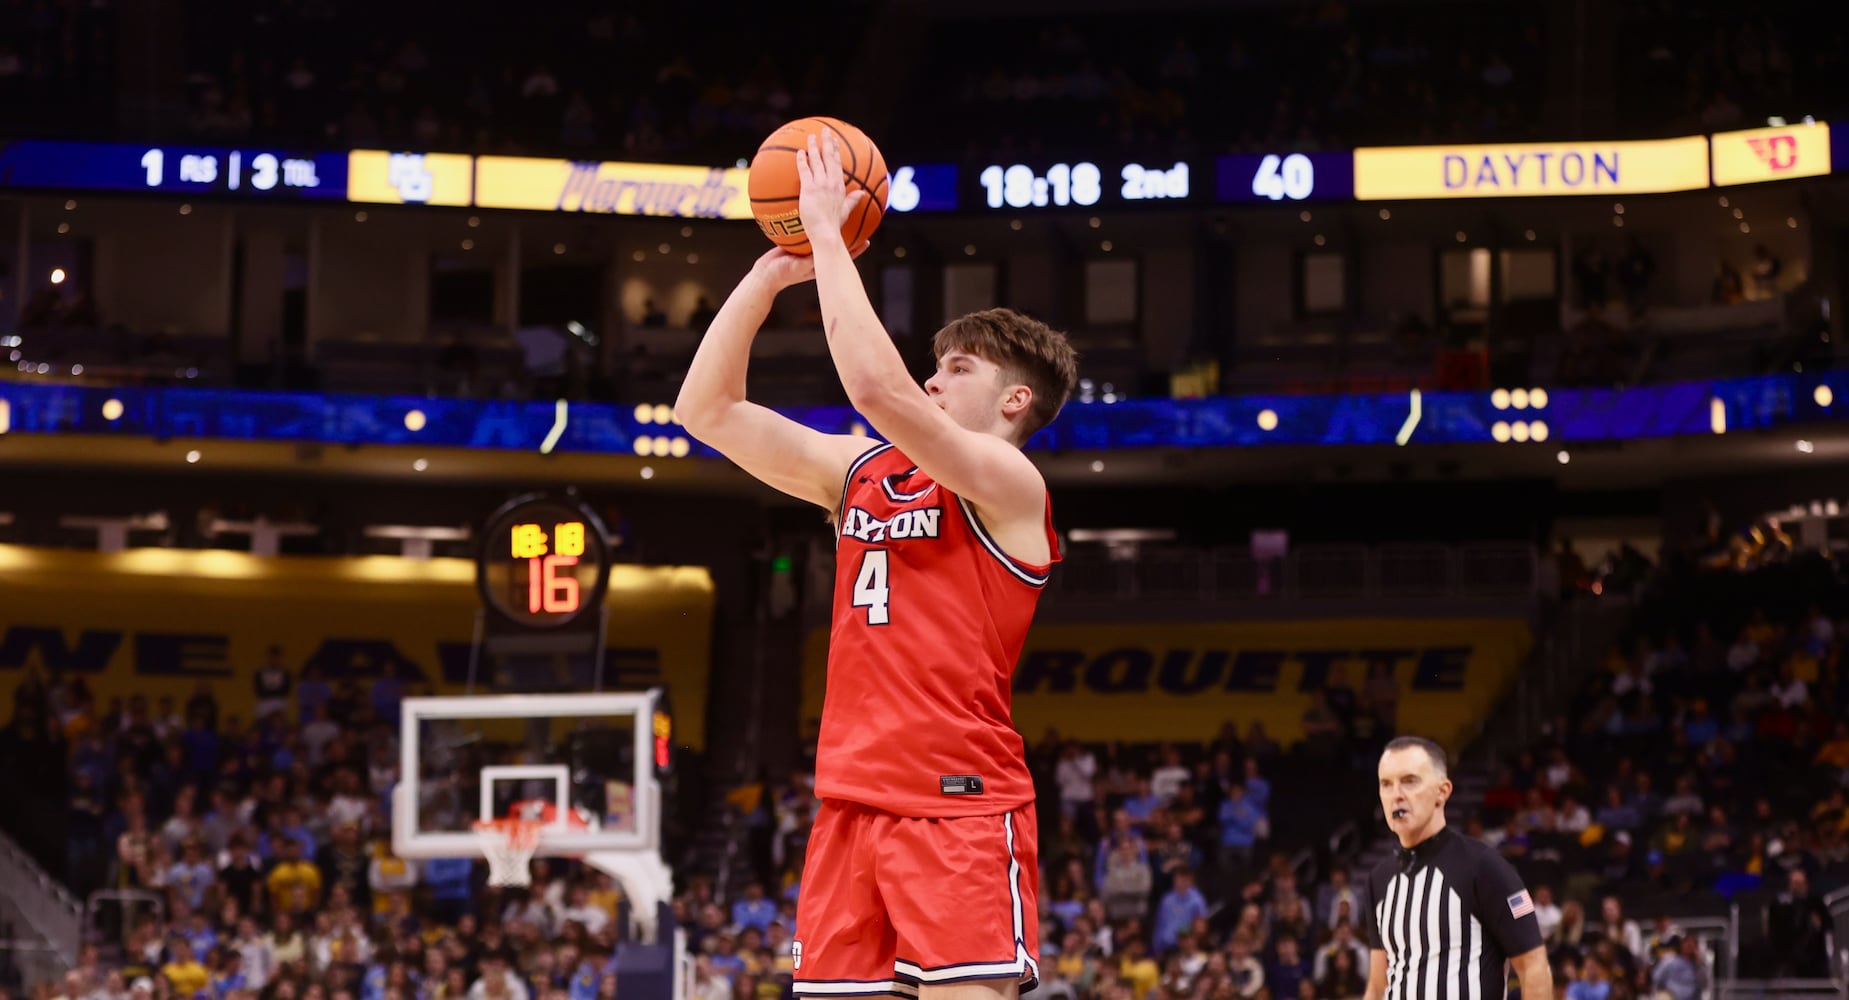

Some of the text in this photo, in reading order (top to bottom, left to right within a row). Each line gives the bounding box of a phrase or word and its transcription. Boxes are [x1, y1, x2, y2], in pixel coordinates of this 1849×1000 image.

[141, 149, 163, 187] 1
[251, 153, 279, 190] 3
[886, 166, 920, 212] 6
[979, 162, 1190, 208] 18:18 2nd
[1252, 153, 1314, 200] 40
[1442, 152, 1621, 190] DAYTON
[529, 554, 579, 614] 16
[852, 548, 890, 626] 4
